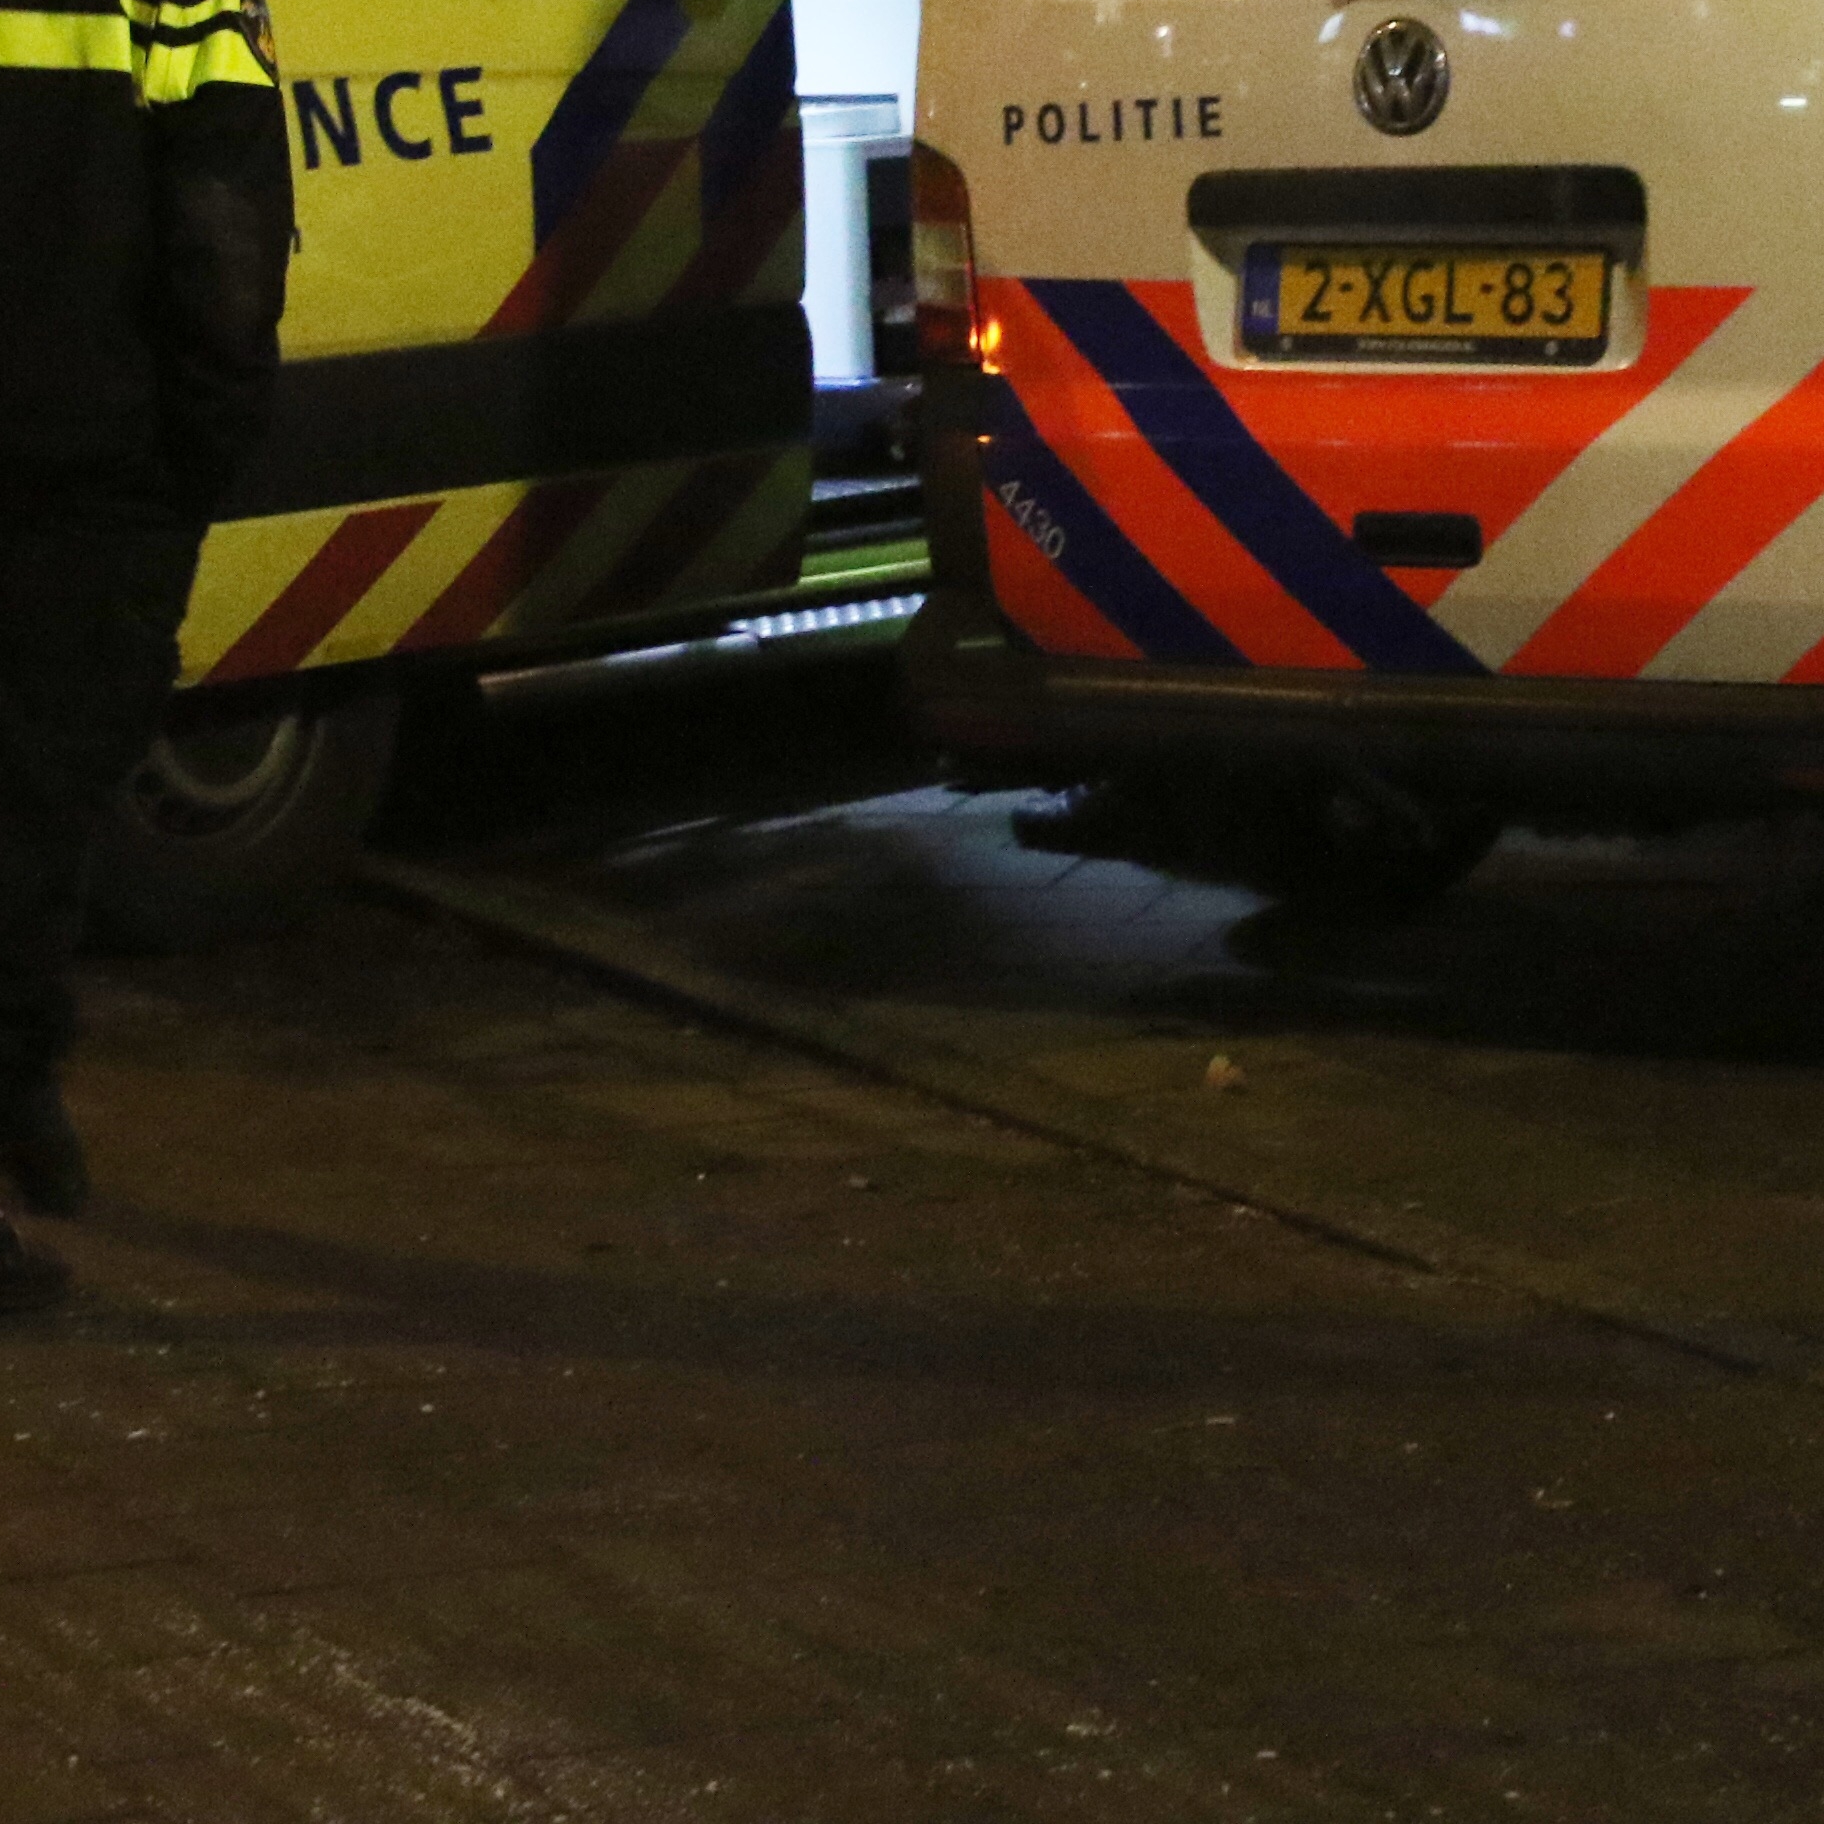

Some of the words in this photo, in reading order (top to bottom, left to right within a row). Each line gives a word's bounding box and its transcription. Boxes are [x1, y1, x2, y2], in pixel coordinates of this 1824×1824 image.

[291, 64, 494, 171] NCE
[1002, 96, 1223, 145] POLITIE
[1301, 258, 1574, 326] 2-XGL-83
